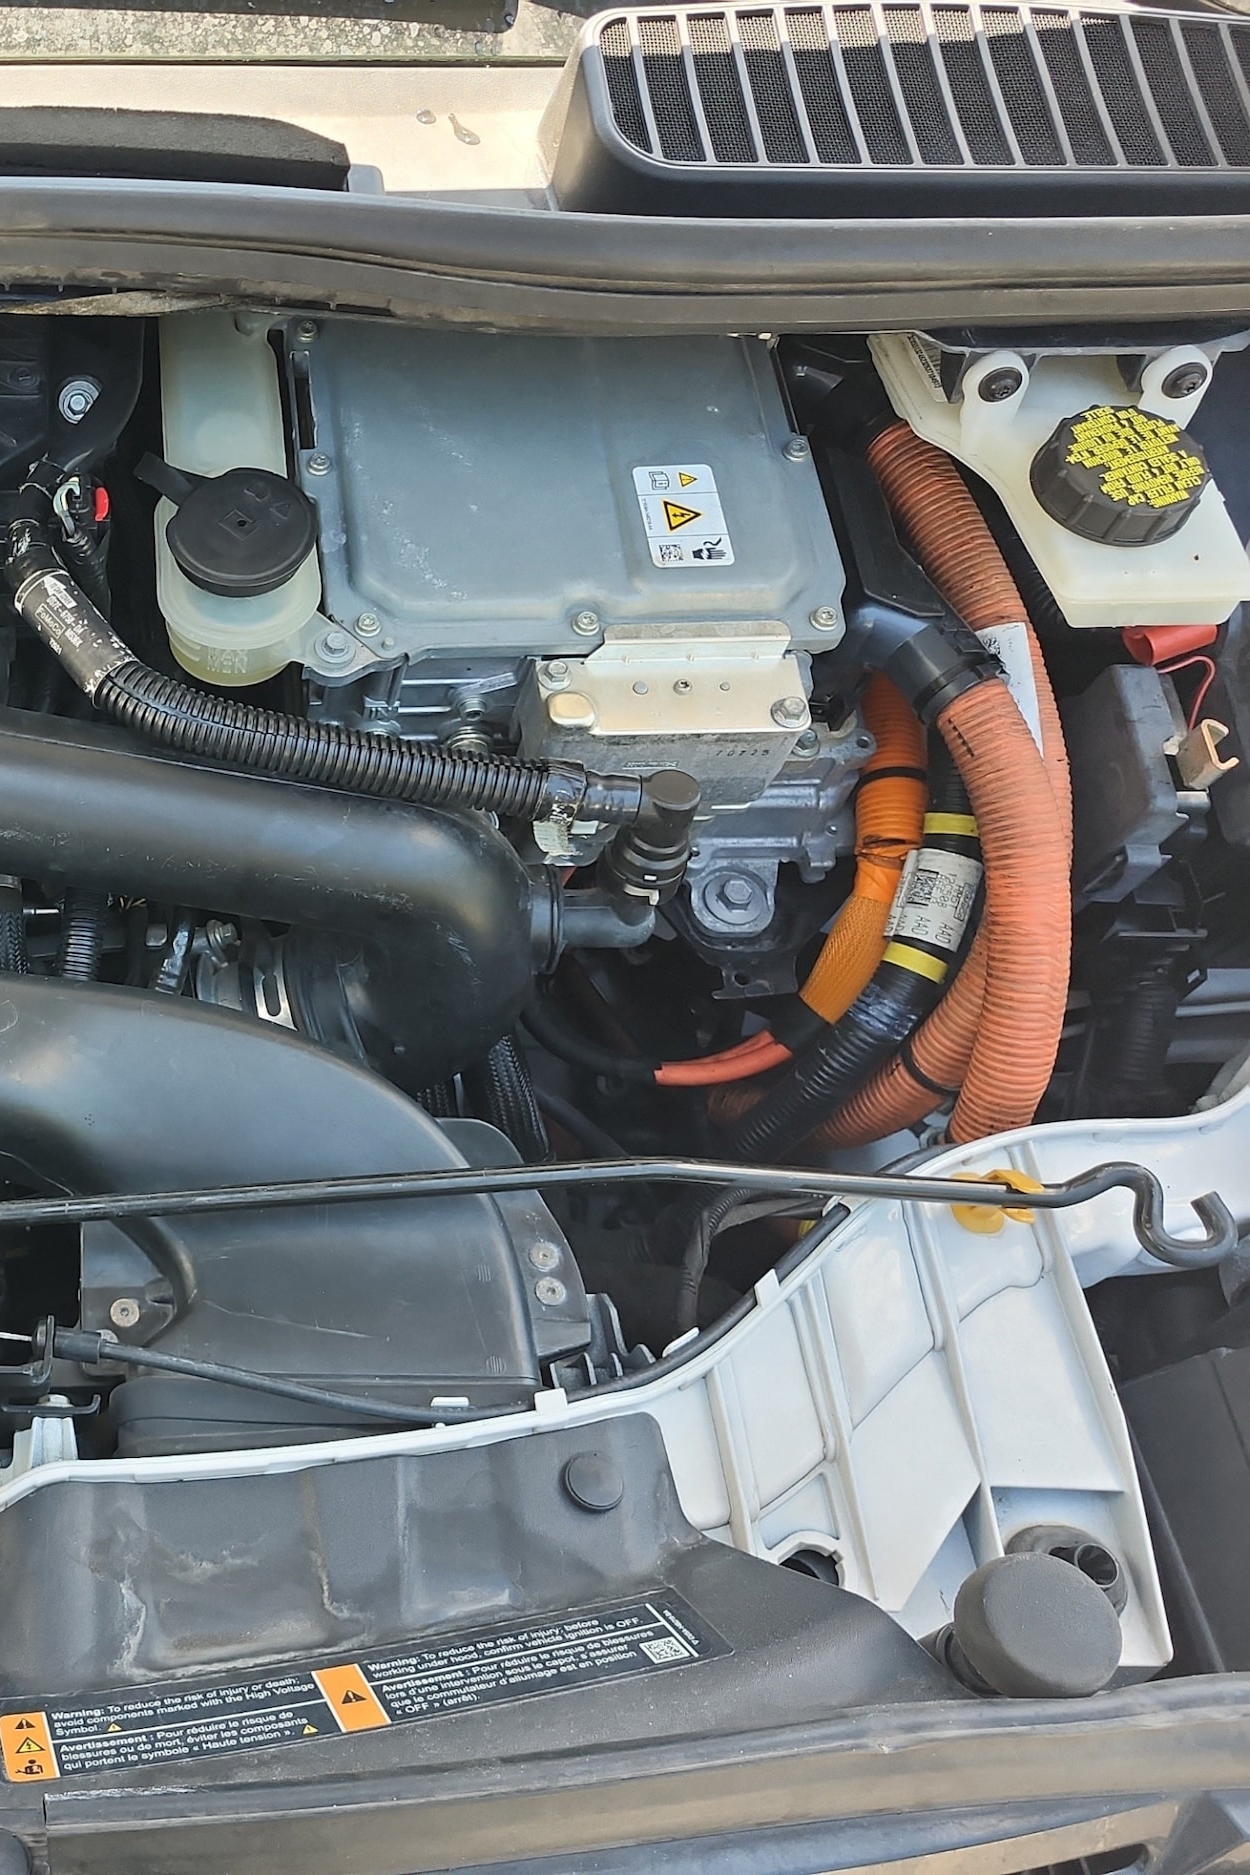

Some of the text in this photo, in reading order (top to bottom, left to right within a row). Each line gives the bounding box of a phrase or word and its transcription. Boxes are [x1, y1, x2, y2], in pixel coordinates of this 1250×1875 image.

[1130, 414, 1148, 424] DOT
[1134, 419, 1166, 432] PLOYER
[1154, 424, 1180, 436] AVANT
[1102, 432, 1116, 442] DU
[1114, 428, 1134, 438] QUE
[1126, 434, 1142, 444] LE
[1140, 430, 1156, 440] DE
[1082, 434, 1180, 468] NETTOYER LE BOUCHON
[1148, 452, 1180, 467] SEALED
[1178, 450, 1188, 458] A
[1100, 456, 1201, 494] ONLY DOT 4 FLUID FROM
[1172, 466, 1206, 480] BEFORE
[1109, 488, 1128, 501] USE
[1128, 476, 1202, 506] CLEAN FILLER CAP
[1147, 490, 1190, 508] WARNING:
[37, 606, 62, 636] FoMoCo
[935, 922, 955, 944] AAD
[368, 1656, 420, 1671] Warning:
[438, 1646, 474, 1657] reduce
[496, 1636, 516, 1645] risk
[564, 1620, 599, 1632] before
[373, 1666, 415, 1678] working
[418, 1658, 448, 1670] under
[484, 1642, 524, 1656] confirm
[526, 1634, 562, 1647] vehicle
[565, 1627, 603, 1640] ignition
[616, 1618, 643, 1628] OFF.
[382, 1670, 464, 1692] Avertissement
[472, 1665, 498, 1674] Pour
[500, 1655, 538, 1668] réduire
[539, 1652, 550, 1660] le
[552, 1646, 584, 1658] risque
[587, 1642, 600, 1650] de
[602, 1630, 654, 1646] blessures
[385, 1645, 628, 1700] lors d'une intervention sous le capot, s'assurer
[390, 1700, 412, 1708] que
[427, 1682, 496, 1700] commutateur
[498, 1668, 558, 1685] d'allumage
[560, 1664, 578, 1672] est
[578, 1660, 594, 1668] en
[595, 1652, 637, 1666] position
[51, 1708, 105, 1720] Warning:
[107, 1705, 121, 1714] To
[124, 1700, 161, 1711] reduce
[164, 1696, 181, 1705] the
[184, 1693, 204, 1702] risk
[206, 1690, 217, 1698] of
[220, 1686, 248, 1698] injury
[54, 1718, 84, 1728] avoid
[87, 1708, 154, 1724] components
[157, 1702, 198, 1714] marked
[200, 1698, 222, 1708] with
[246, 1690, 270, 1700] High
[272, 1684, 314, 1694] Voltage
[405, 1702, 429, 1713] OFF
[56, 1724, 101, 1736] Symbol.
[60, 1736, 148, 1752] Avertissement
[157, 1730, 184, 1738] Pour
[186, 1722, 226, 1734] réduire
[228, 1720, 239, 1728] le
[242, 1715, 276, 1726] risque
[279, 1712, 293, 1720] de
[61, 1748, 117, 1760] blessures
[154, 1738, 184, 1748] mort,
[187, 1732, 218, 1743] éviter
[220, 1730, 238, 1738] les
[240, 1718, 308, 1734] composants
[64, 1762, 82, 1770] qui
[85, 1756, 126, 1768] portent
[128, 1754, 138, 1762] le
[141, 1747, 190, 1760] symbole
[202, 1740, 238, 1750] Haute
[240, 1732, 281, 1744] tension
